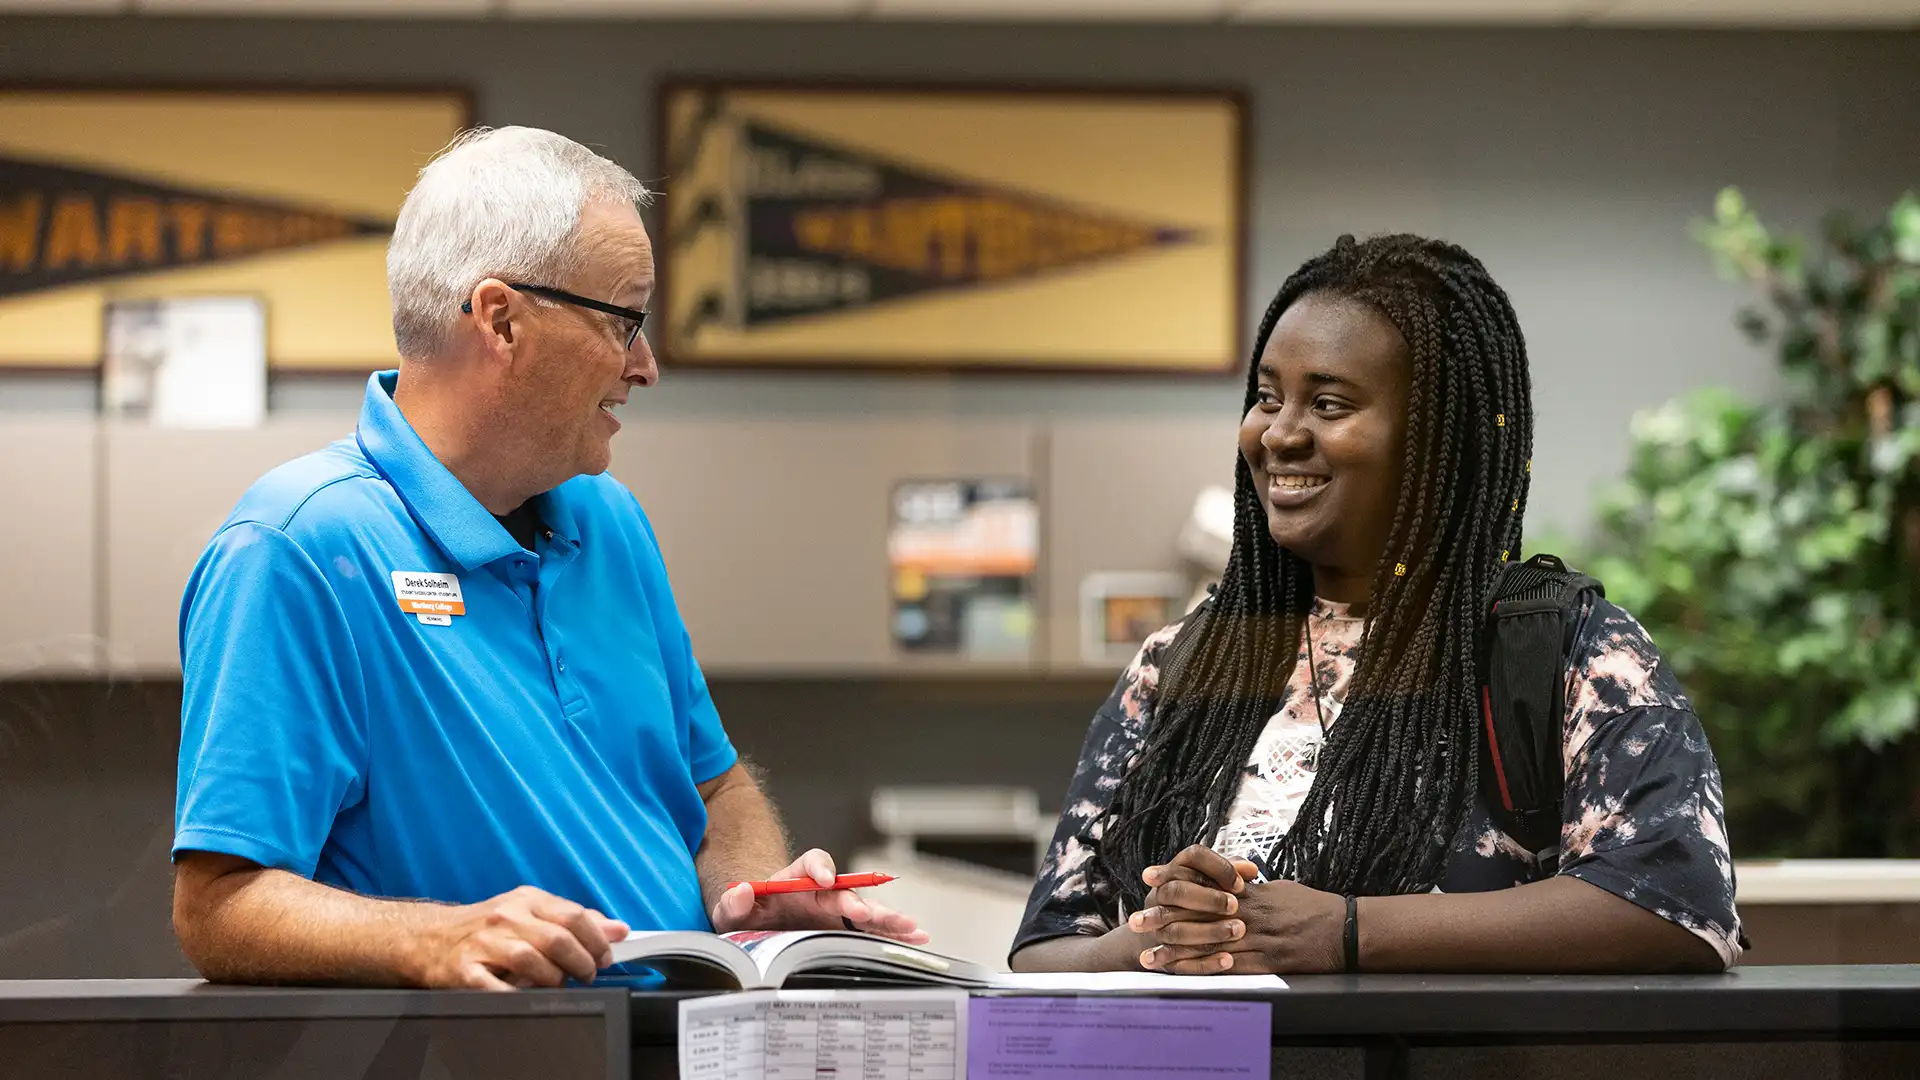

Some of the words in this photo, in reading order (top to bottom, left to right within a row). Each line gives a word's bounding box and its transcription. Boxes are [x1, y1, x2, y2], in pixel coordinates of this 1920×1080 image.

[0, 193, 354, 273] WARTB
[792, 196, 1152, 277] WARTB
[405, 577, 424, 588] Derek
[424, 578, 450, 589] Solheim
[773, 1001, 791, 1009] MAY
[818, 1001, 861, 1009] SCHEDULE
